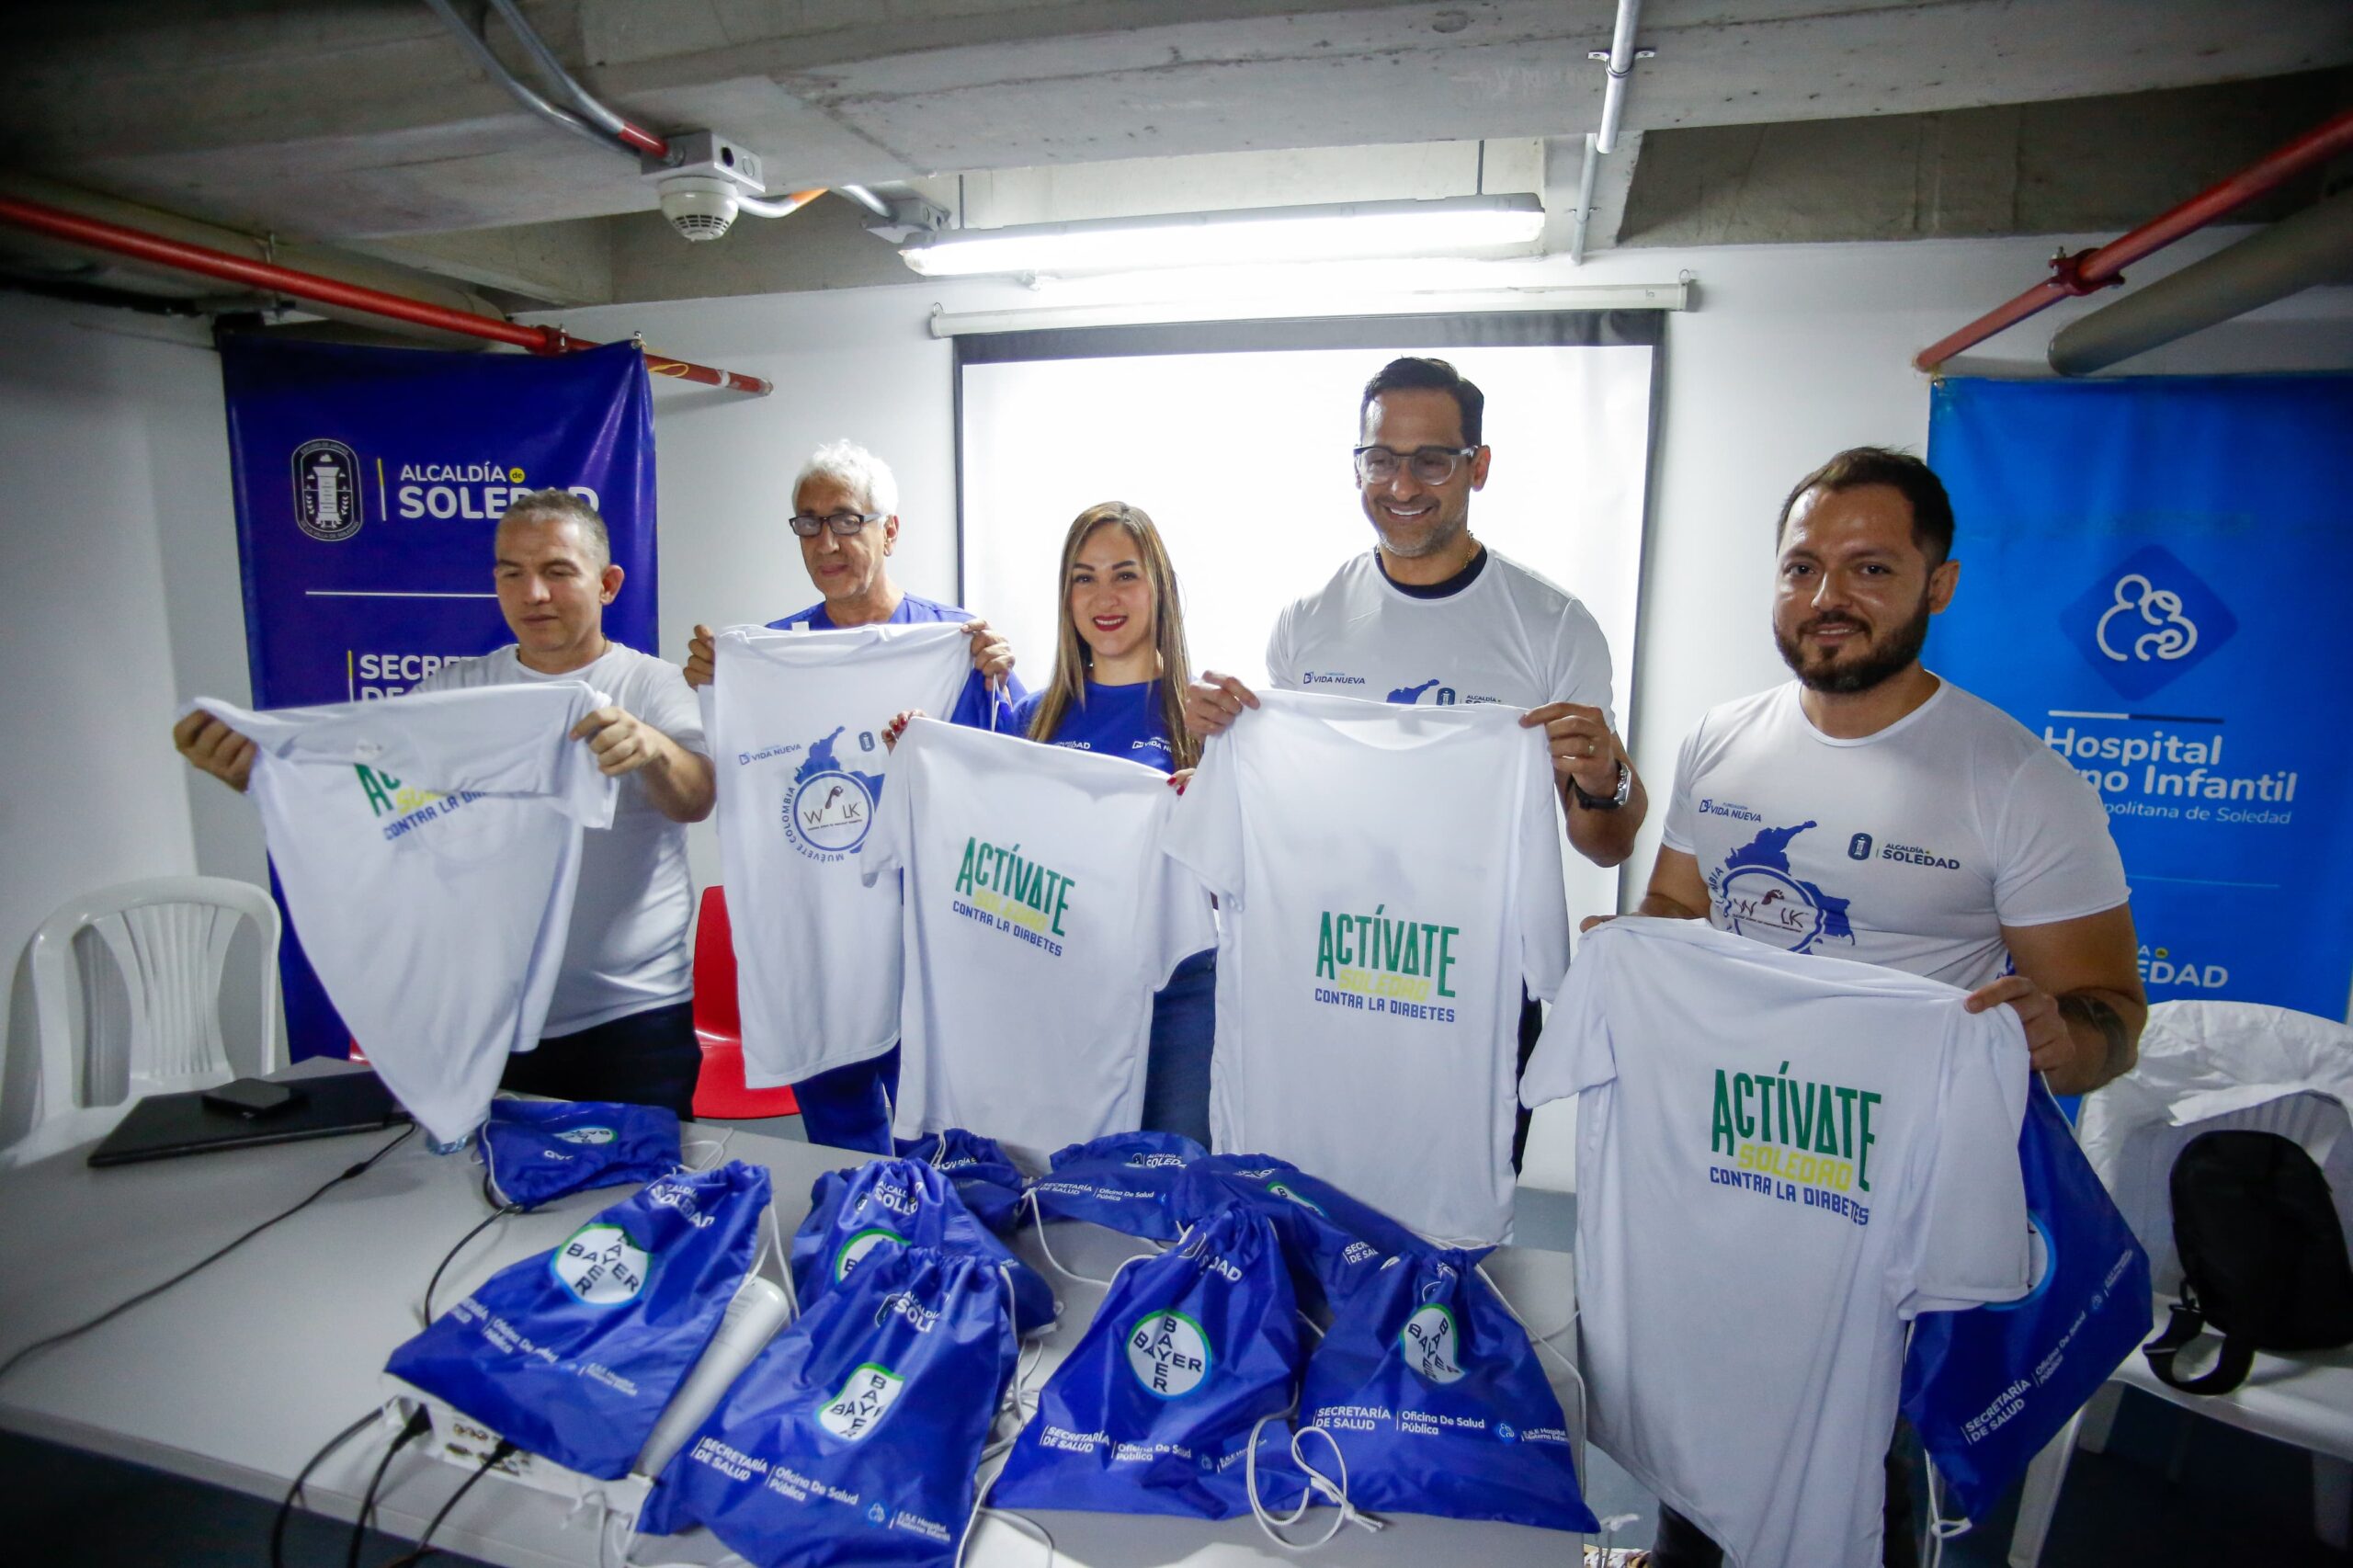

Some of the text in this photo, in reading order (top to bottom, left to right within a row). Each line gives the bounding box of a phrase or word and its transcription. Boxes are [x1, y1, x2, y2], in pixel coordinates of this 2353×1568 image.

[400, 460, 506, 483] ALCALDÍA
[1313, 676, 1366, 685] VIDA NUEVA
[752, 751, 772, 762] VIDA
[774, 744, 801, 756] NUEVA
[2044, 725, 2222, 767] Hospital
[2144, 765, 2298, 801] Infantil
[781, 786, 796, 844] COLOMBIA
[1711, 805, 1762, 823] VIDA NUEVA
[2186, 805, 2210, 821] de
[2216, 807, 2292, 824] Soledad
[1881, 849, 1961, 869] SOLEDAD
[1885, 843, 1924, 854] ALCALDÍA
[955, 836, 1075, 937] ACTÍVATE
[953, 900, 1063, 957] CONTRA LA DIABETES
[1315, 904, 1459, 998] ACTÍVATE
[1315, 988, 1455, 1023] CONTRA LA DIABETES
[1711, 1061, 1881, 1192] ACTÍVATE
[1737, 1142, 1853, 1192] SOLEDAD
[1710, 1166, 1870, 1226] CONTRA LA DIABETES
[566, 1243, 640, 1292] BAYER
[1349, 1252, 1362, 1264] DE
[1133, 1330, 1202, 1373] BAYER
[1153, 1316, 1177, 1393] BAYER
[1315, 1417, 1376, 1431] DE SALUD
[1317, 1405, 1392, 1420] SECRETARÍA
[1402, 1411, 1485, 1429] Oficina De Salud
[1965, 1379, 2031, 1434] SECRETARÍA
[1972, 1398, 2026, 1443] DE SALUD
[1041, 1436, 1095, 1454] DE SALUD
[1046, 1426, 1110, 1447] SECRETARÍA
[1402, 1422, 1439, 1436] Pública
[695, 1448, 751, 1483] DE SALUD
[702, 1437, 768, 1472] SECRETARÍA
[1155, 1443, 1170, 1453] De
[769, 1478, 806, 1503] Pública
[775, 1466, 859, 1506] Oficina De Salud
